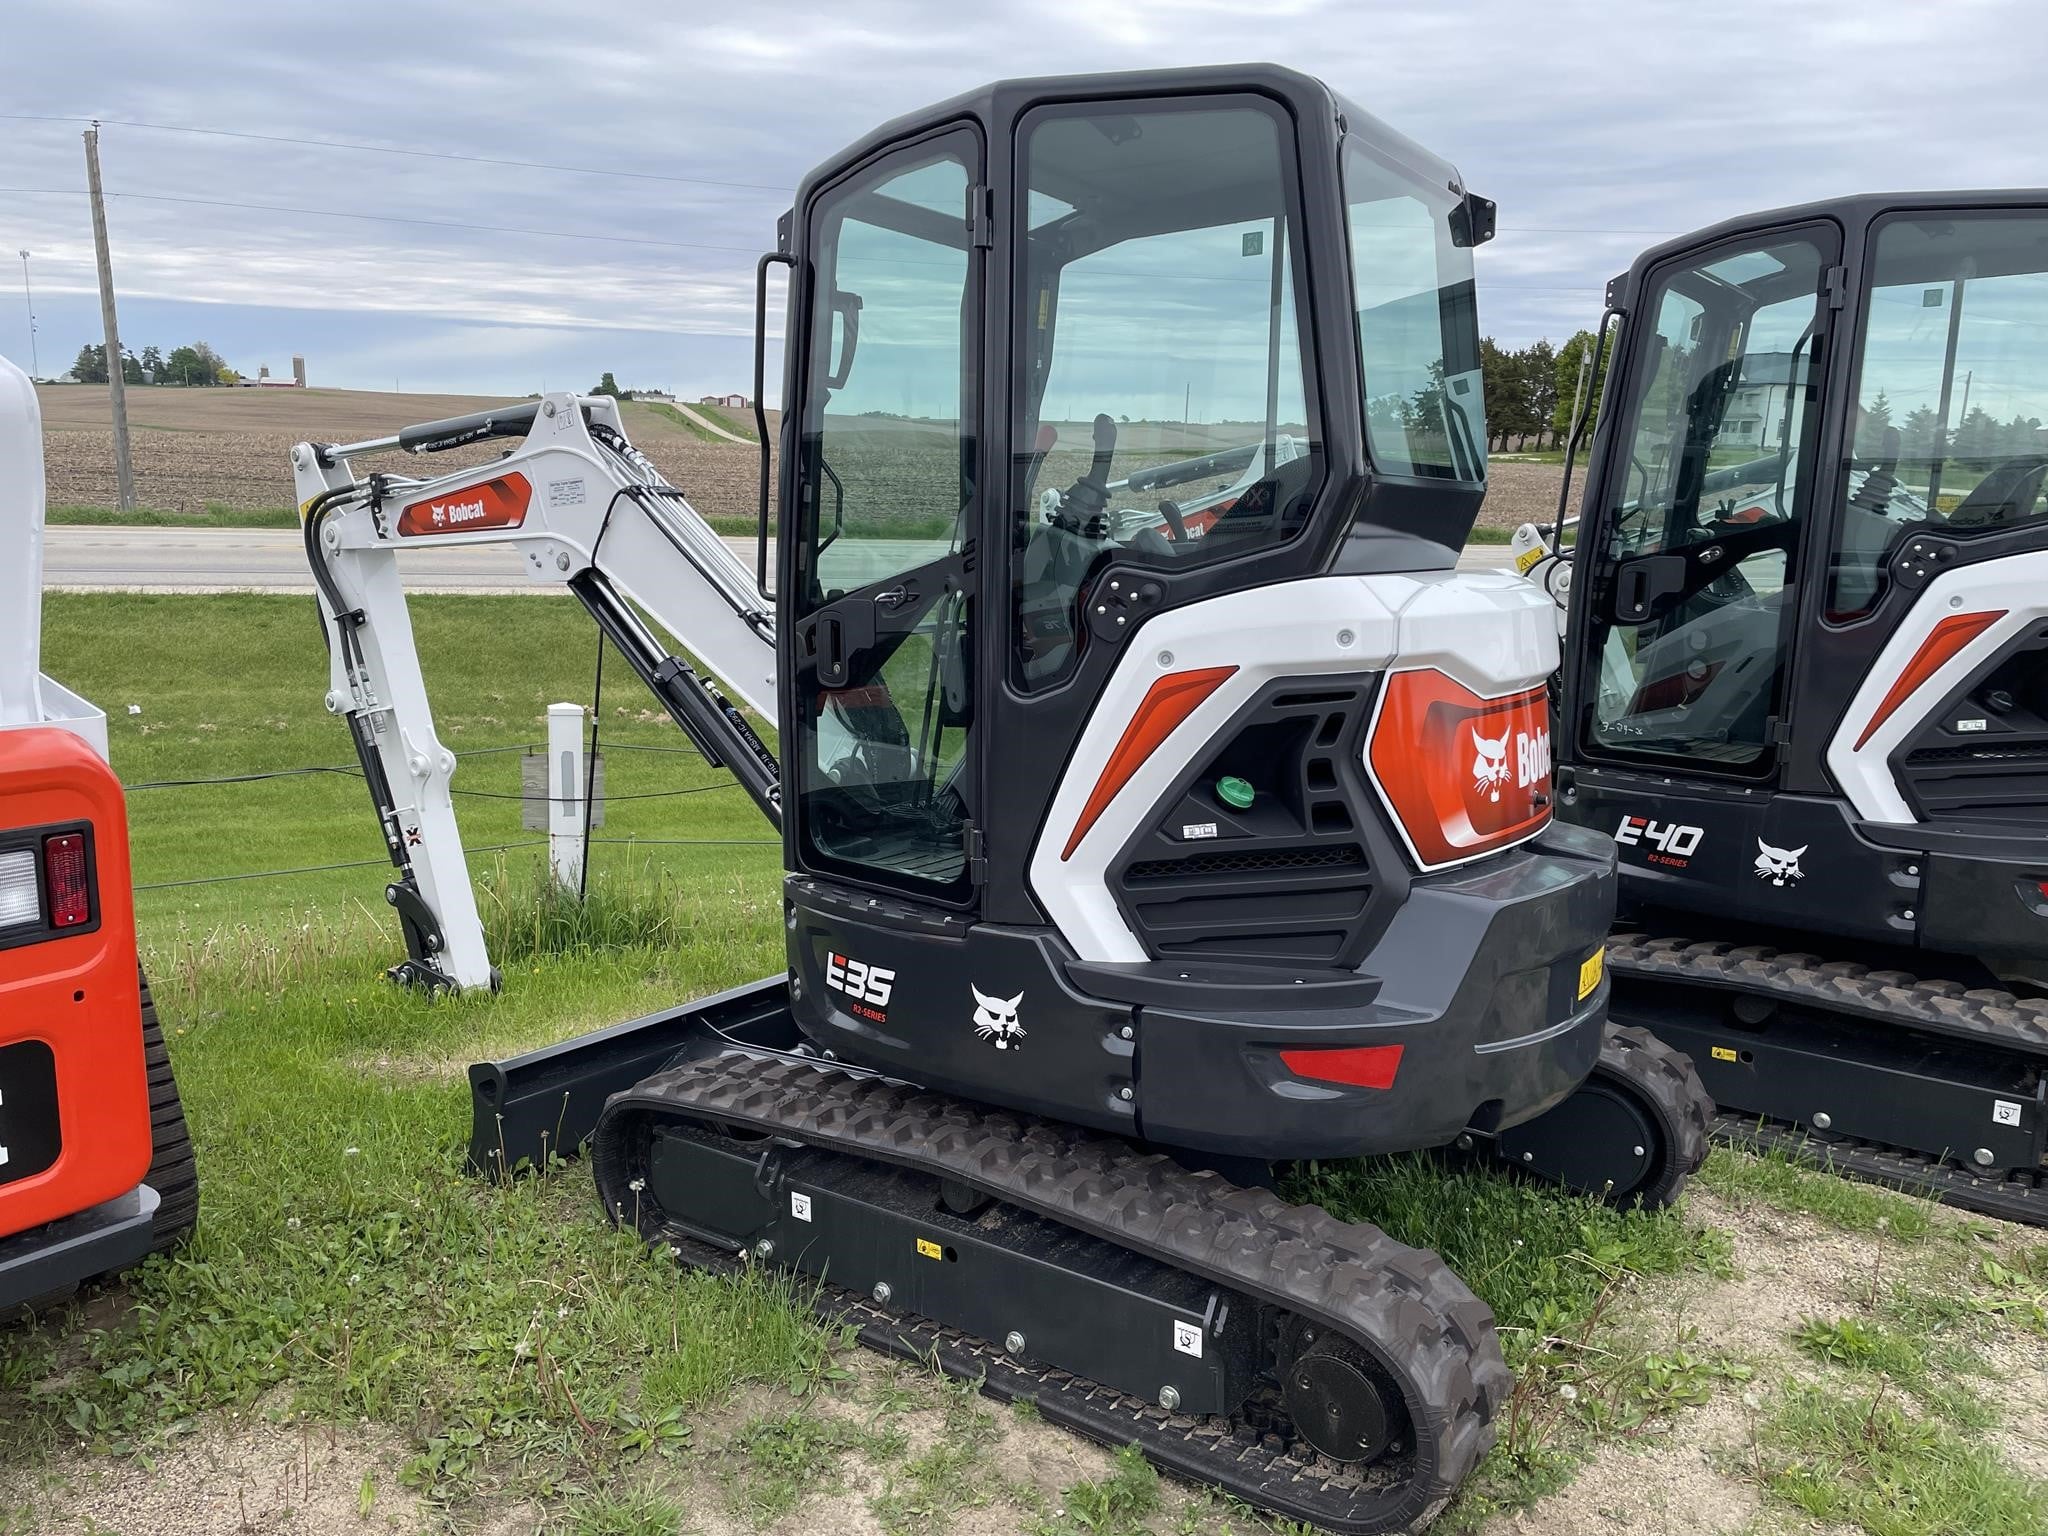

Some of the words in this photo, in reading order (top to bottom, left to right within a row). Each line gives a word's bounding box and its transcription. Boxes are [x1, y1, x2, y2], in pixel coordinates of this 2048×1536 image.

[448, 499, 486, 523] Bobcat
[744, 730, 761, 751] MSHA
[1614, 814, 1705, 857] E40
[1647, 853, 1689, 869] R2-SERIES
[826, 951, 896, 1007] E35
[853, 1003, 887, 1024] R2-SERIES
